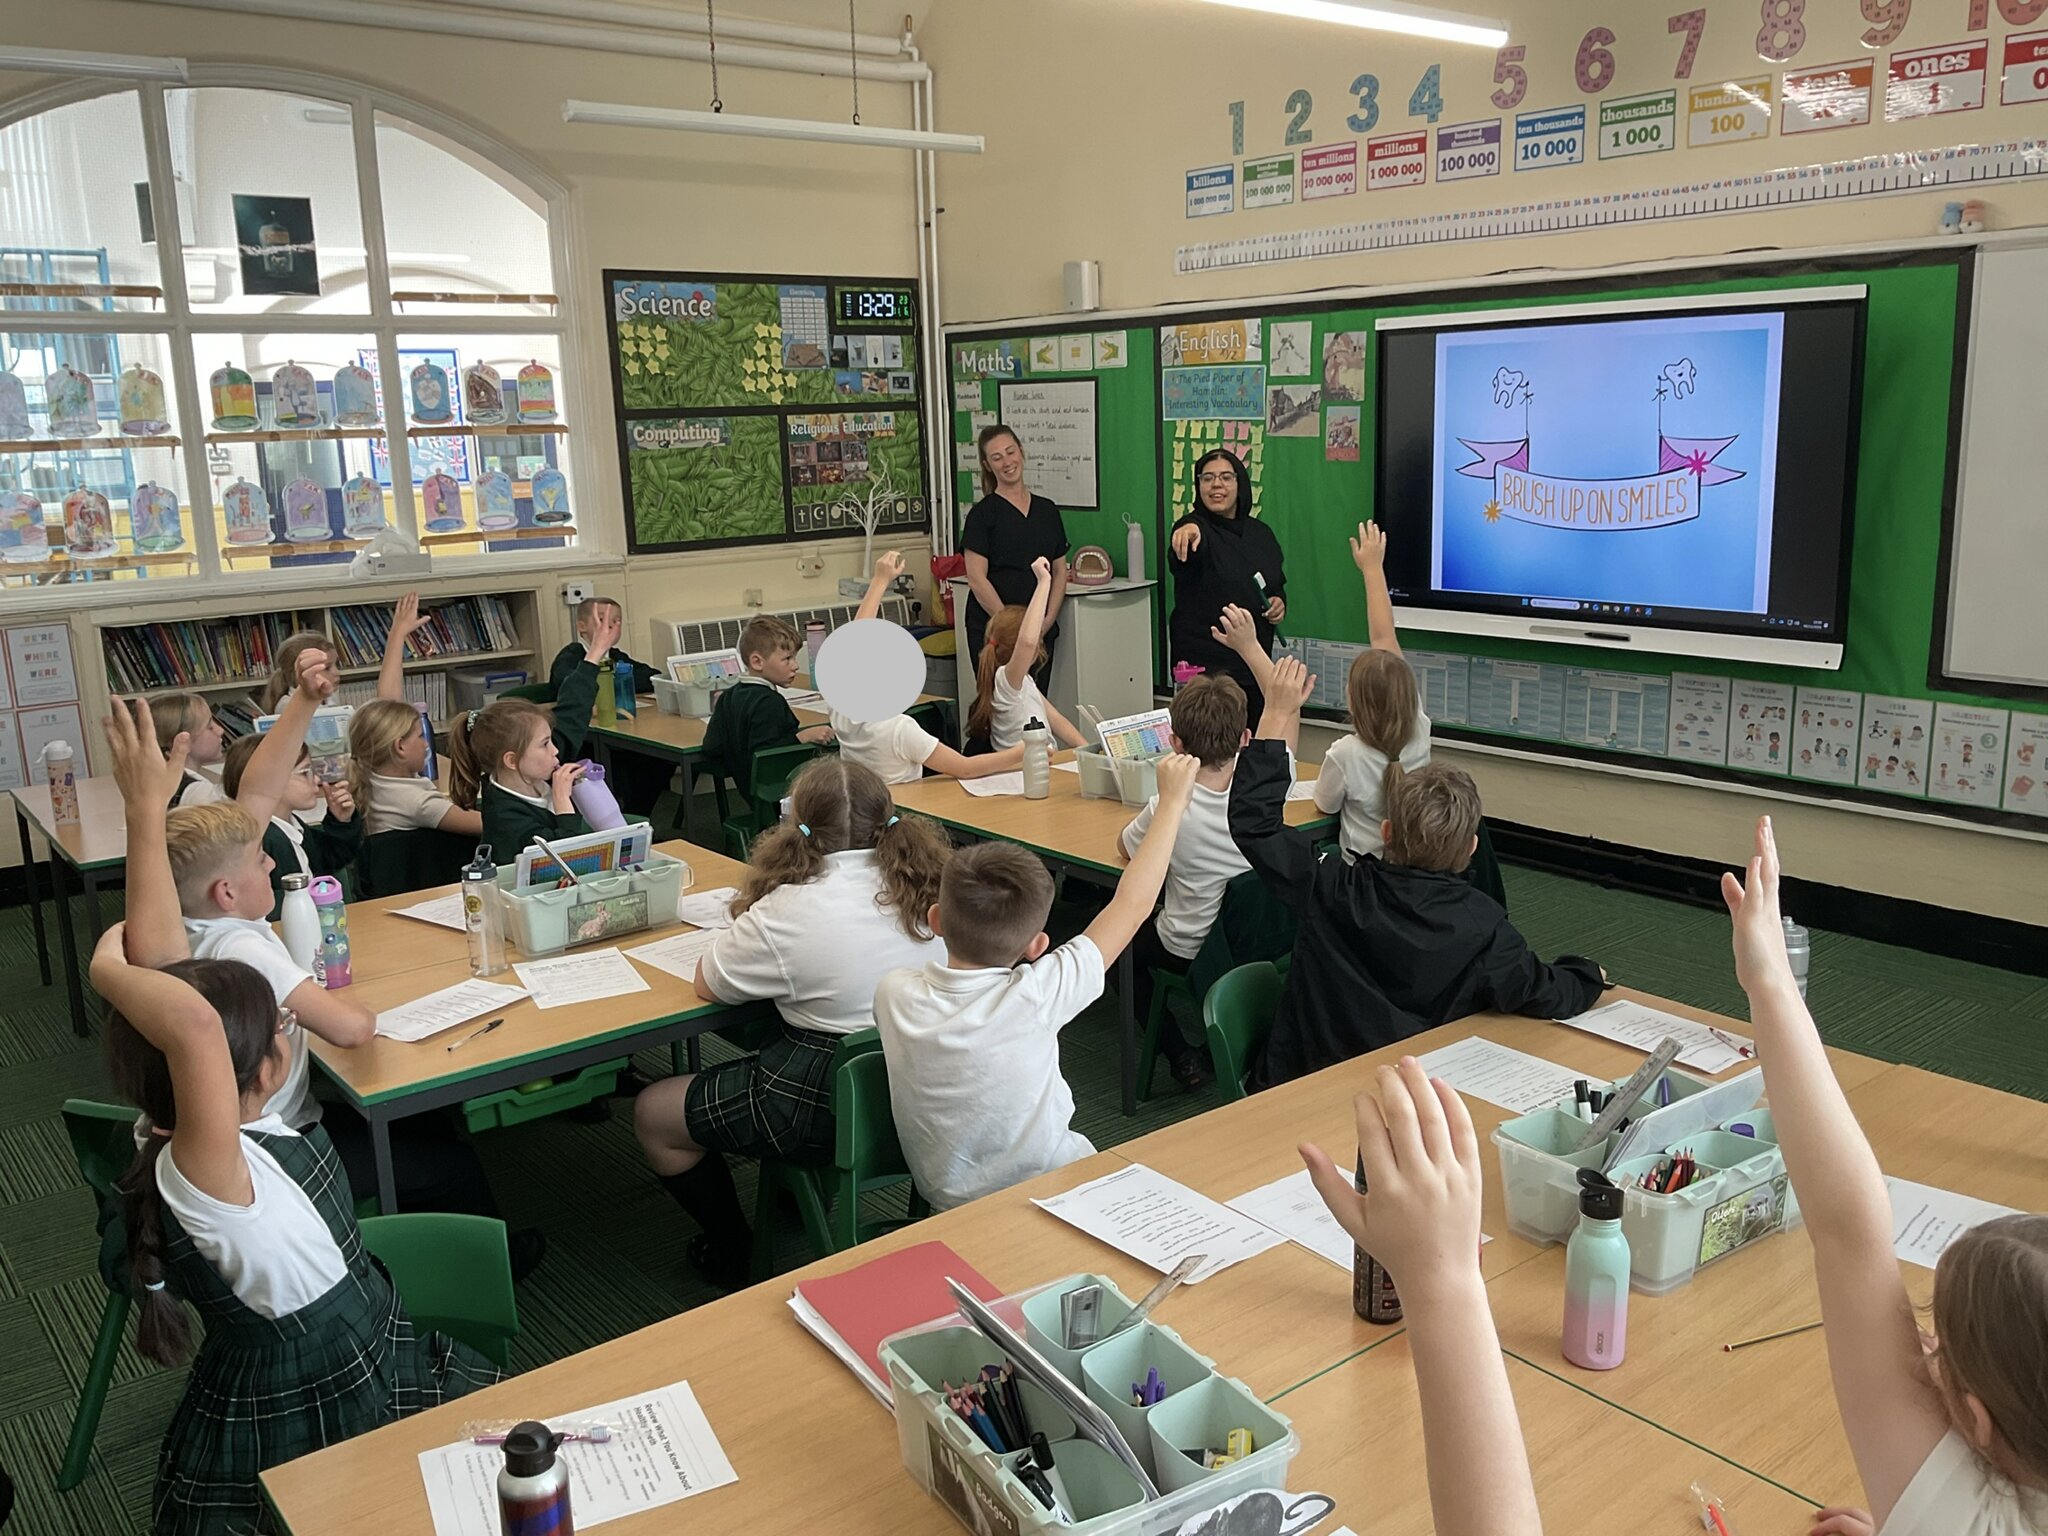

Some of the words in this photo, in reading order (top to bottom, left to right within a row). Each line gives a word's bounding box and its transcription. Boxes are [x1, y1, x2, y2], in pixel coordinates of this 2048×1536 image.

[1668, 8, 1706, 79] 7
[1575, 27, 1616, 93] 6
[1904, 52, 1970, 78] ones
[1490, 45, 1526, 109] 5
[1346, 74, 1380, 132] 3
[1408, 64, 1443, 123] 4
[1928, 82, 1940, 104] 1
[1285, 89, 1312, 145] 2
[1602, 100, 1674, 122] thousands
[1229, 101, 1244, 156] 1
[1518, 124, 1532, 135] ten
[1534, 115, 1584, 132] thousands
[1710, 113, 1745, 134] 100
[1612, 132, 1621, 148] 1
[1626, 124, 1661, 145] 000
[1304, 159, 1316, 168] ten
[1318, 152, 1354, 166] millions
[1374, 142, 1419, 158] millions
[1522, 143, 1540, 160] 10
[1545, 138, 1577, 156] 000
[1370, 168, 1376, 180] 1
[1378, 166, 1398, 178] 000
[1401, 162, 1422, 175] 000
[1440, 156, 1465, 172] 100
[1468, 151, 1496, 168] 000
[1193, 175, 1226, 188] billions
[1260, 186, 1274, 196] 000
[1276, 183, 1291, 194] 000
[1304, 178, 1314, 188] 10
[1315, 176, 1333, 187] 000
[1335, 172, 1354, 184] 000
[620, 286, 712, 318] Science
[859, 294, 894, 317] 13:29
[1180, 328, 1240, 358] English
[960, 348, 1015, 373] Maths
[1178, 374, 1191, 383] The
[1194, 372, 1210, 383] Pied
[1213, 372, 1234, 384] Piper
[1236, 371, 1246, 384] of
[1169, 398, 1208, 410] Interesting
[1210, 398, 1258, 410] Vocabulary
[634, 422, 720, 444] Computing
[790, 422, 839, 437] Religious
[842, 420, 894, 432] Education
[1502, 472, 1556, 520] BRUSH
[1618, 478, 1687, 523] SMILES
[24, 651, 59, 662] WHERE
[30, 668, 58, 678] WERE
[632, 1406, 649, 1429] Healthy
[643, 1402, 659, 1424] Review
[654, 1423, 667, 1440] What
[662, 1440, 673, 1452] You
[668, 1451, 681, 1470] Know
[676, 1469, 692, 1490] About
[976, 1482, 1012, 1530] Badgers
